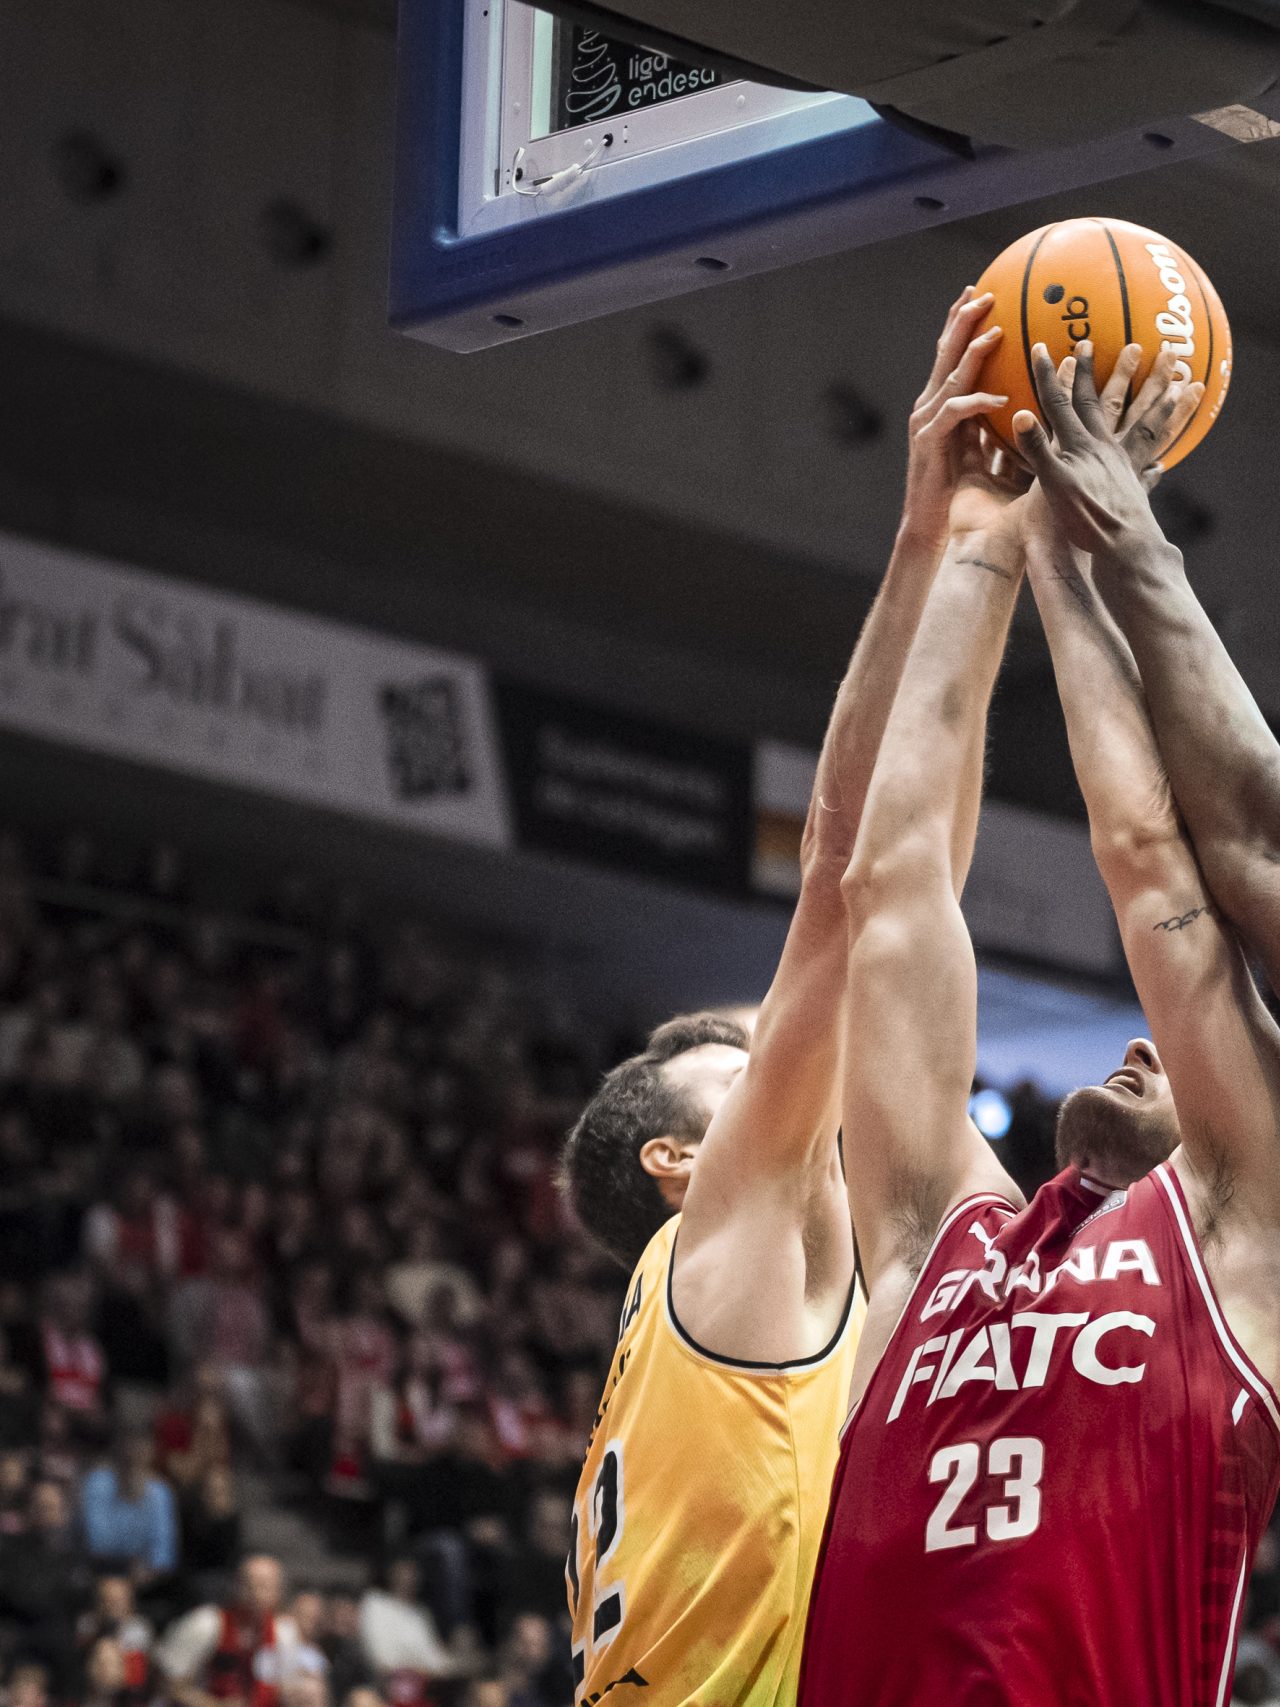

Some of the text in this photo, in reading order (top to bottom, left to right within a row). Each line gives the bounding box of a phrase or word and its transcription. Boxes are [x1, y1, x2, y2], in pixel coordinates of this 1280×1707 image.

[627, 68, 716, 107] endesa
[628, 53, 669, 82] liga
[1060, 295, 1092, 352] cb
[885, 1310, 1157, 1425] FIATC
[924, 1435, 1045, 1555] 23
